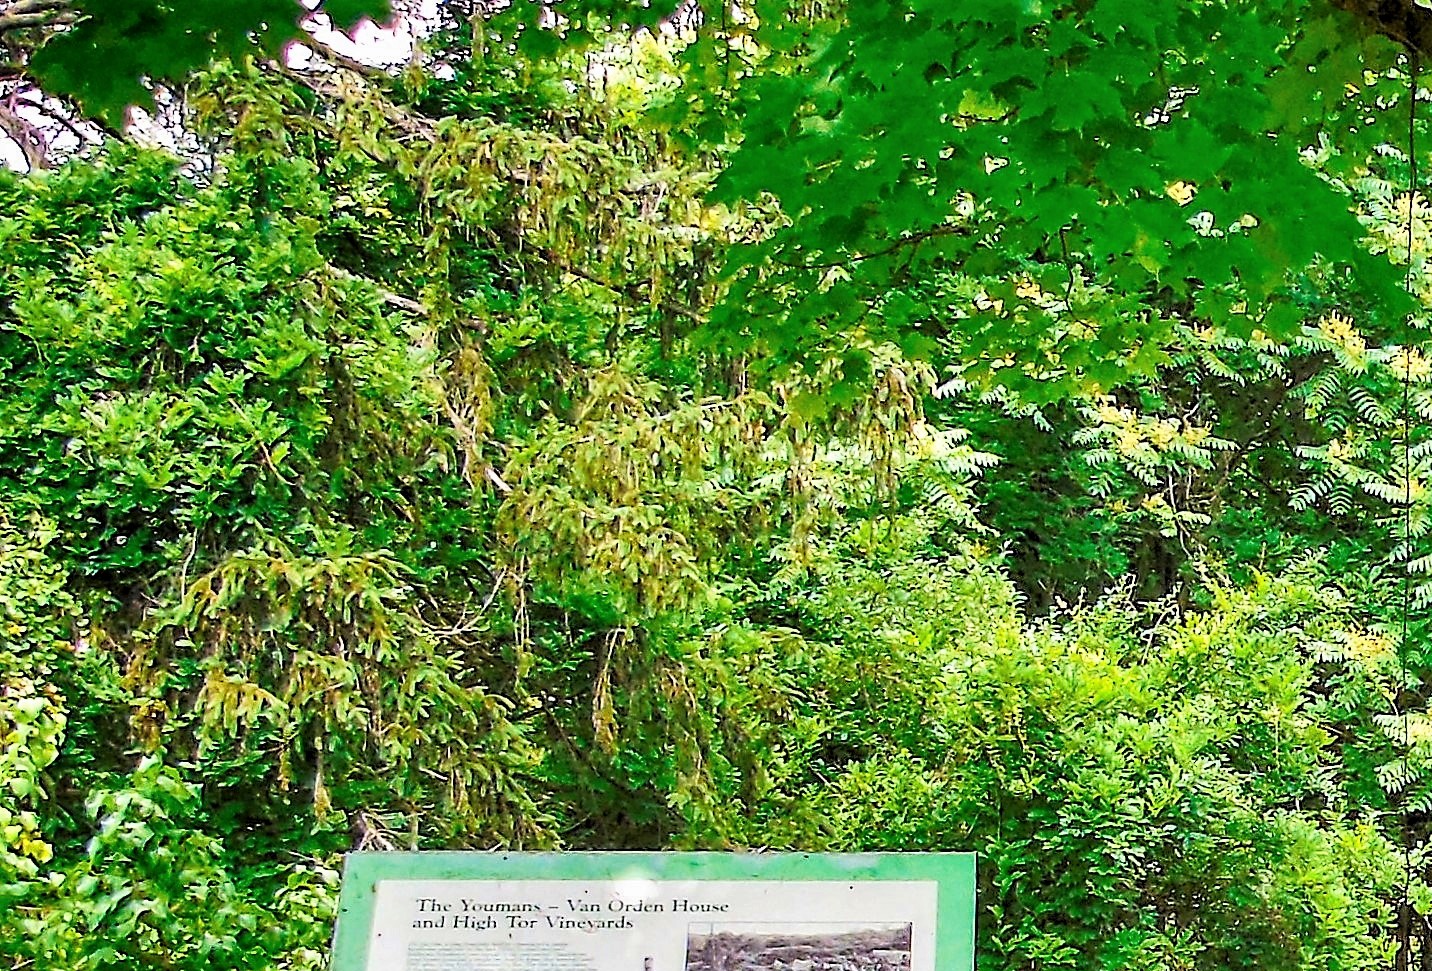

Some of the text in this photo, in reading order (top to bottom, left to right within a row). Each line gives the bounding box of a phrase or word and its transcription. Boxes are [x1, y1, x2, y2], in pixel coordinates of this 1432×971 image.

[416, 898, 453, 913] The
[460, 898, 542, 913] Youmans
[566, 898, 601, 913] Van
[607, 898, 664, 913] Orden
[671, 898, 730, 913] House
[412, 915, 635, 932] and High Tor Vineyards
